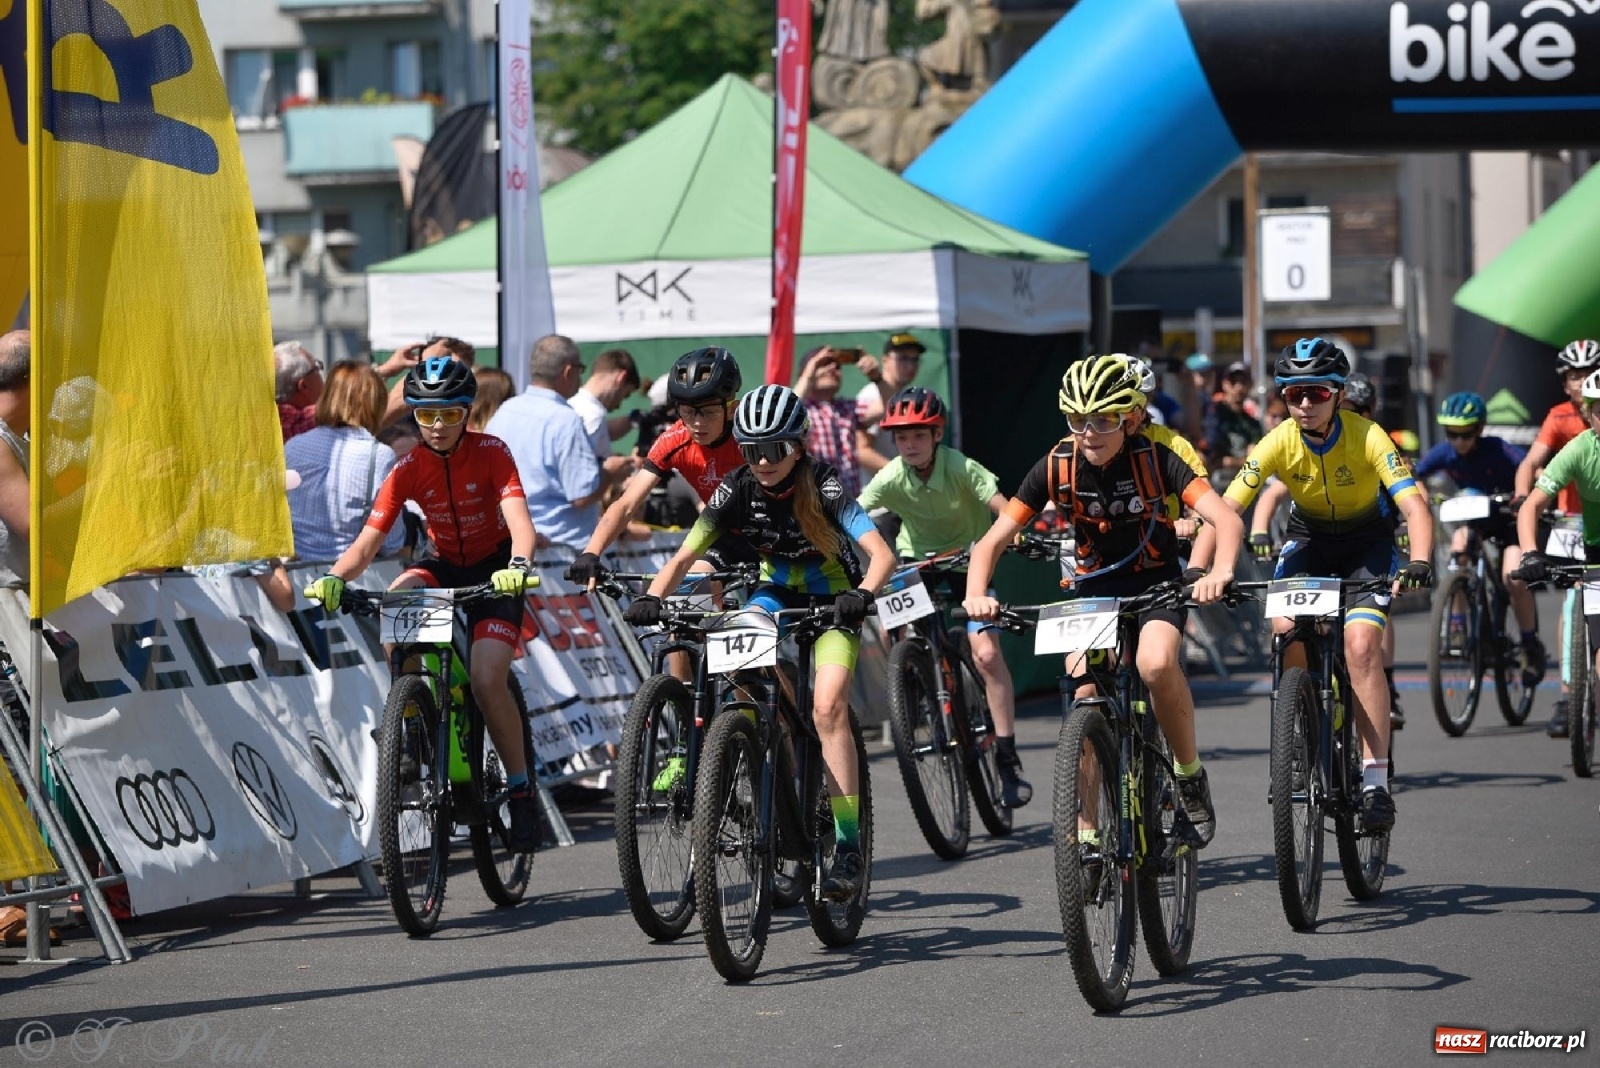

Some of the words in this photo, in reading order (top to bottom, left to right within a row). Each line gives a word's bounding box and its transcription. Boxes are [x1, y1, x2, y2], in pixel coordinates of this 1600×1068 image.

[1390, 1, 1577, 82] bike
[1287, 264, 1305, 290] 0
[886, 592, 915, 614] 105
[1284, 592, 1322, 606] 187
[401, 609, 432, 629] 112
[1057, 616, 1099, 637] 157
[487, 622, 517, 641] Nice
[722, 632, 759, 655] 147
